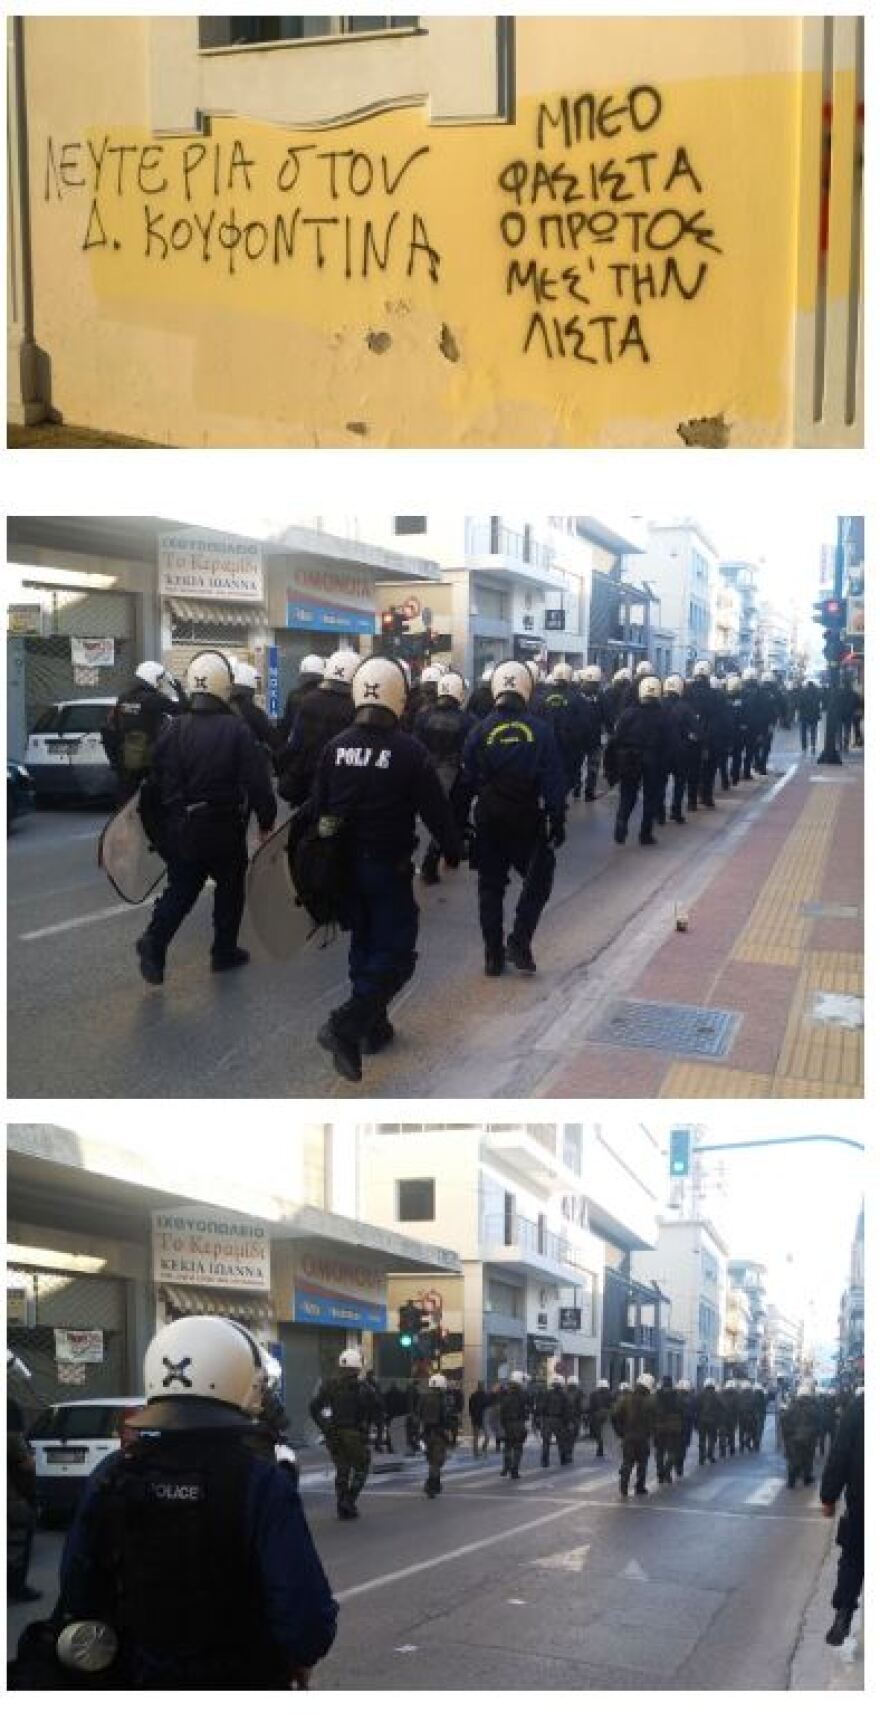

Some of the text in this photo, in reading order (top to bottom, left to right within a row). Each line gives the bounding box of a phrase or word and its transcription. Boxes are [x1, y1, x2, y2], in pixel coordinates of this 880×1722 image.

[536, 84, 662, 149] ΜΠΕΟ
[498, 146, 703, 206] ΦΑΣΙΣΤΑ
[523, 311, 650, 364] ΛΙΣΤΑ
